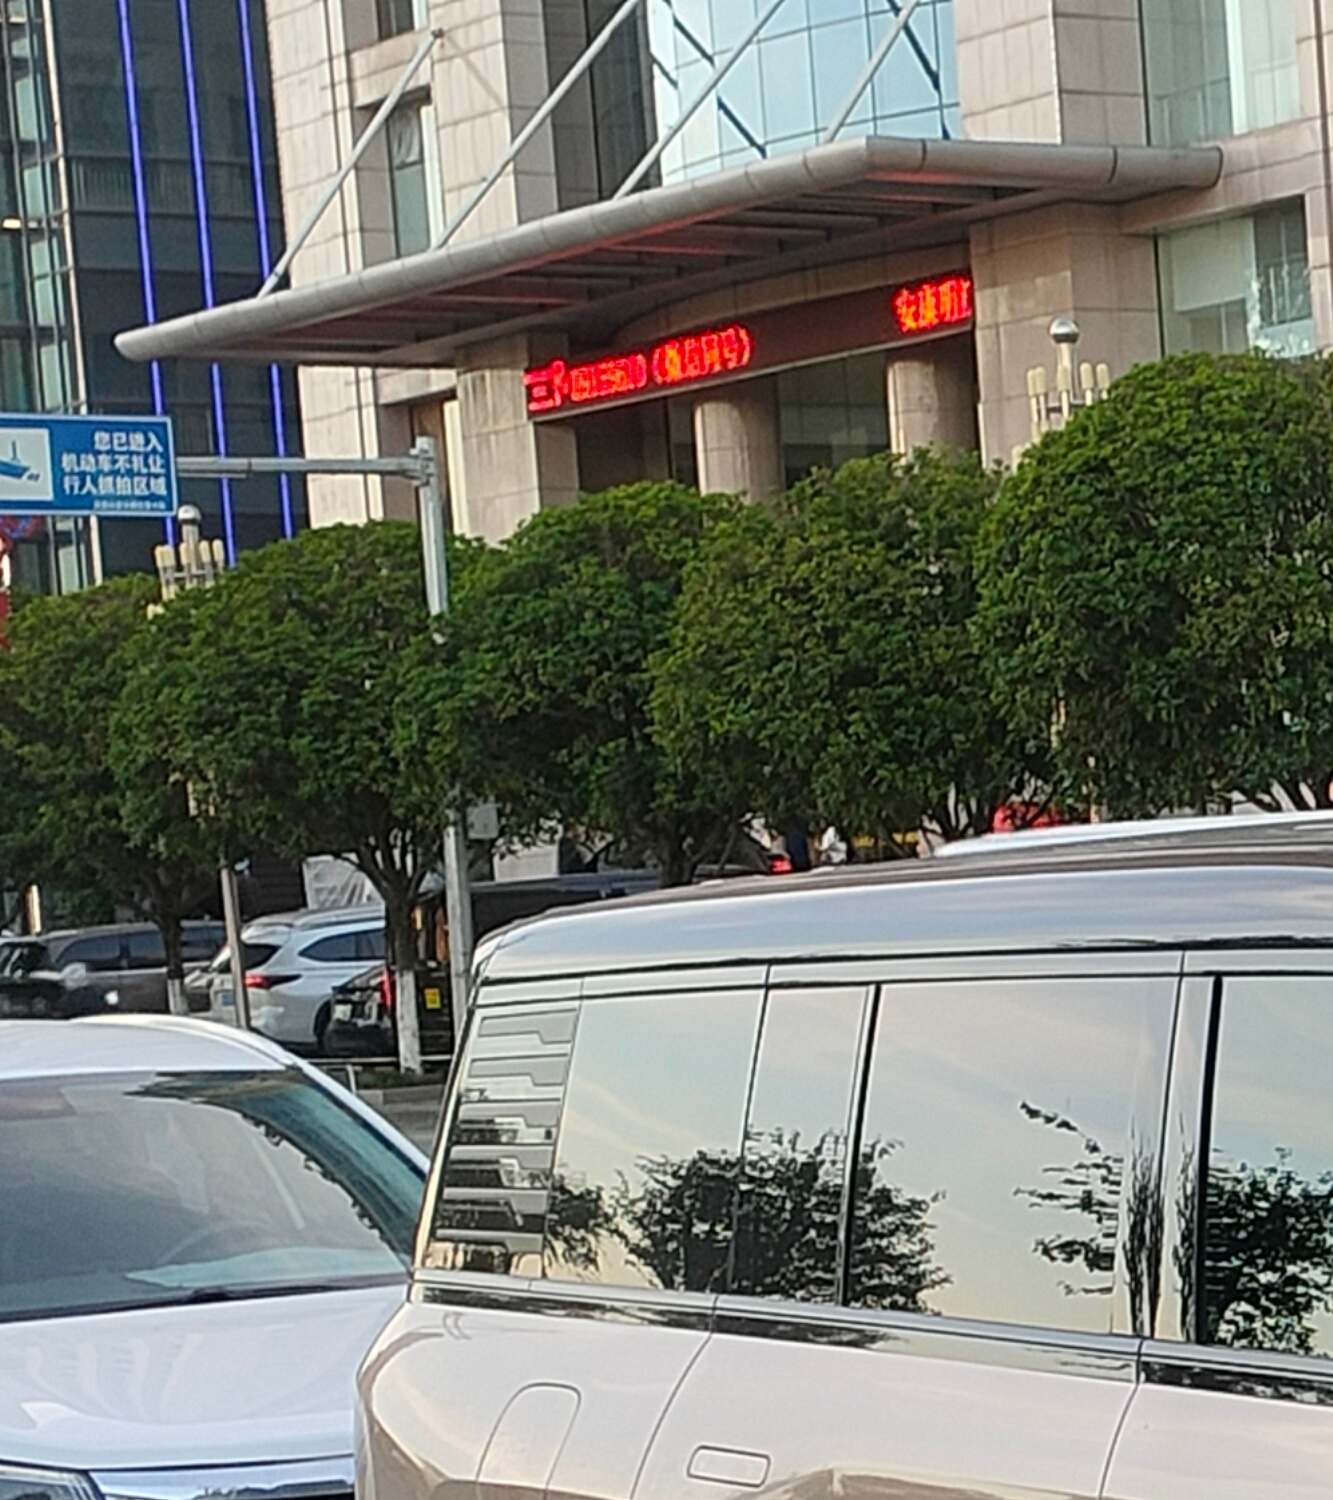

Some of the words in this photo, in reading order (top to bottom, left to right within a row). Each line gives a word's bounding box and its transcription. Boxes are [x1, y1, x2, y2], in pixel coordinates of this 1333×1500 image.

[94, 431, 164, 452] 您已进入
[61, 452, 166, 474] 机动车不礼让
[63, 475, 168, 496] 行人抓拍区域
